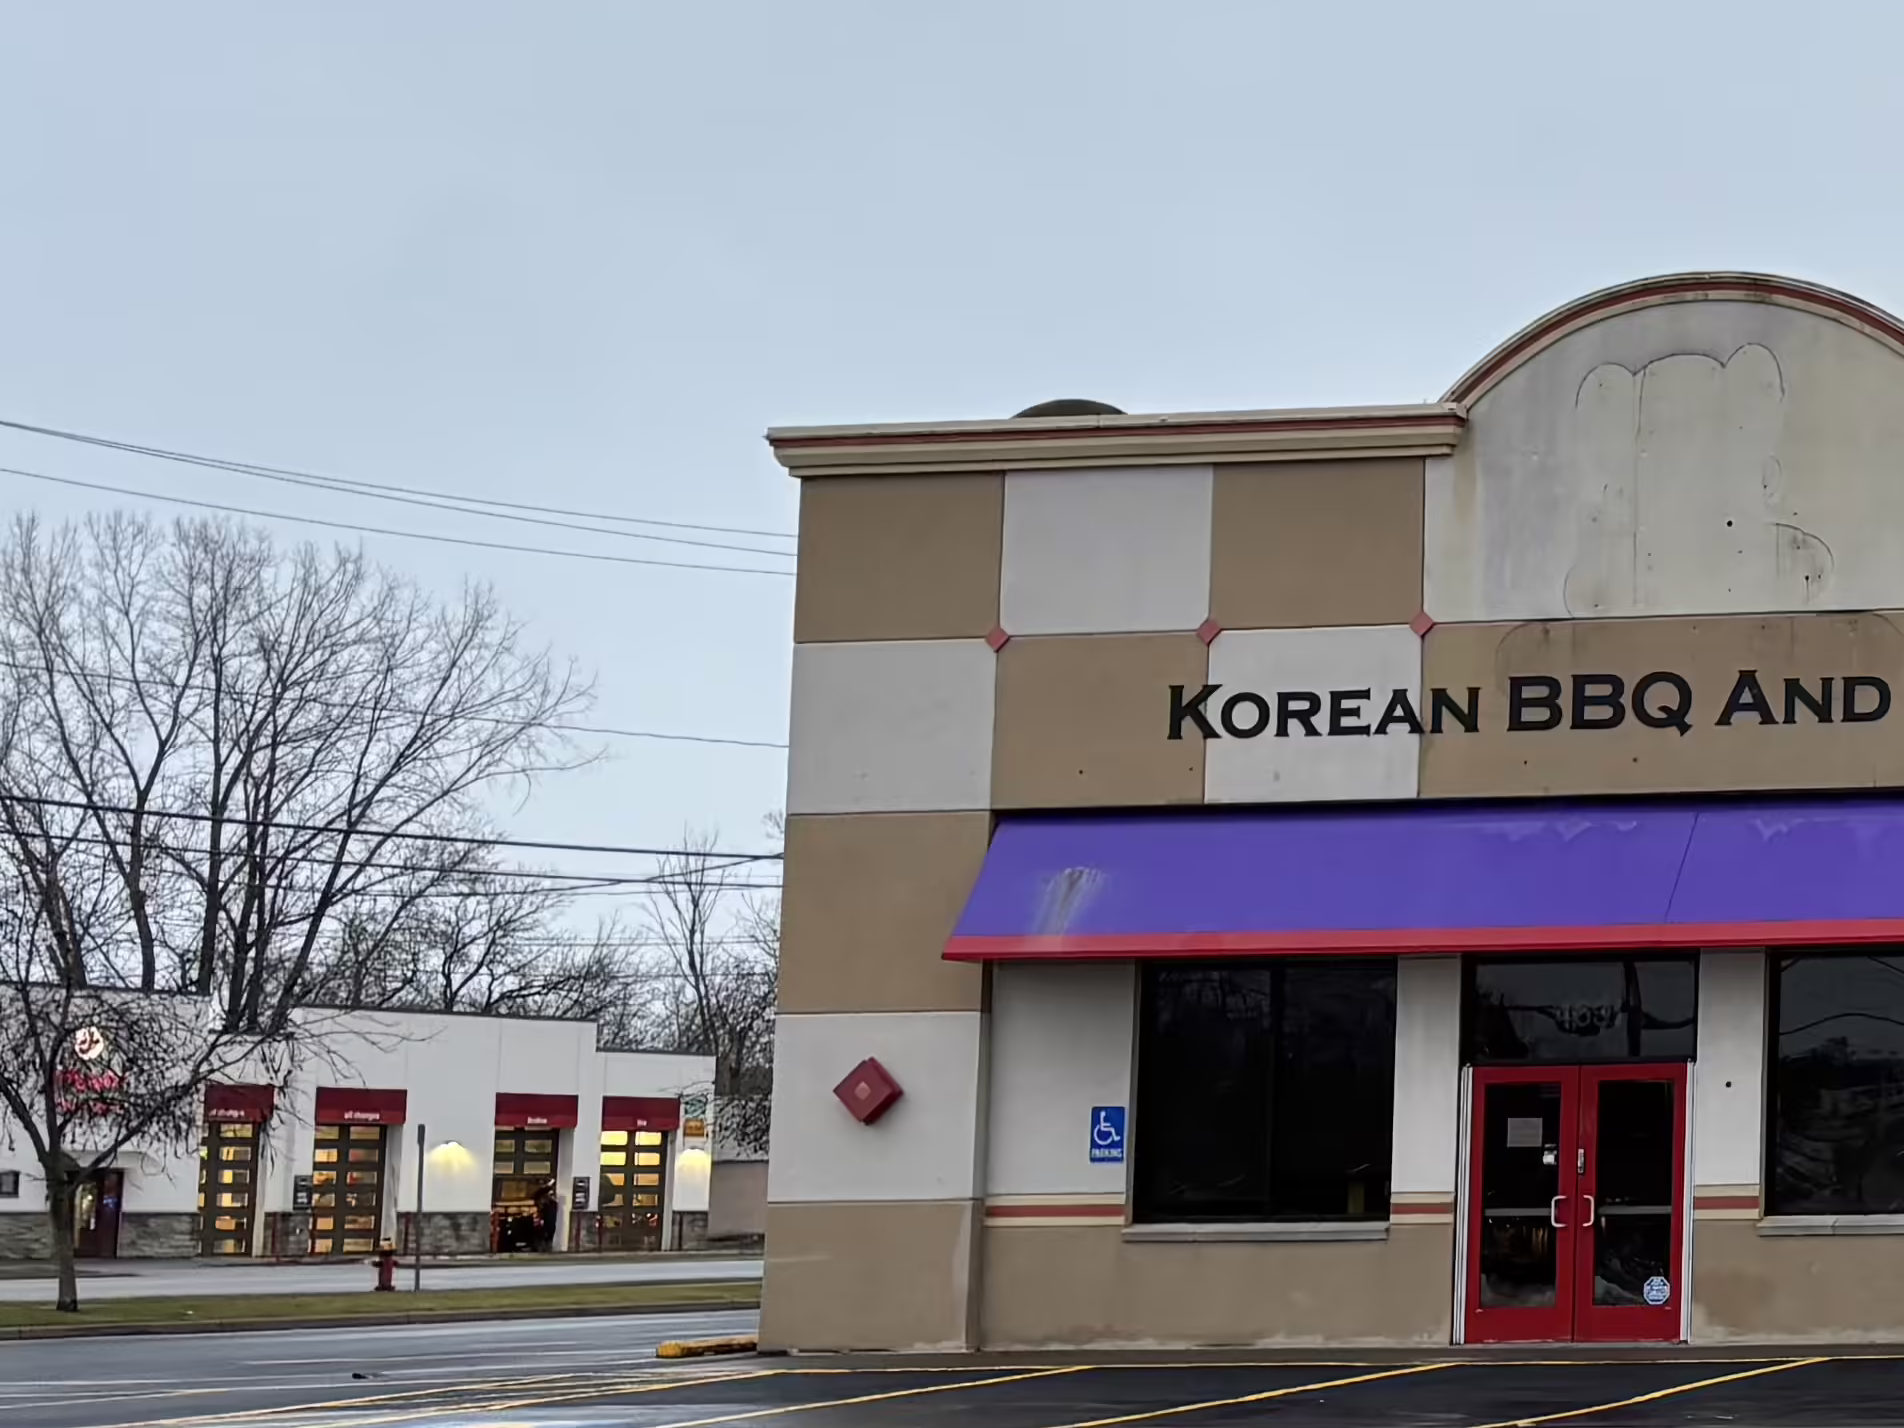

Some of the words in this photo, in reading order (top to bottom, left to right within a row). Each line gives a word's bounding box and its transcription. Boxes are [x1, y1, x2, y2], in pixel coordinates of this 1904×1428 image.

[1166, 683, 1482, 742] KOREAN
[1506, 670, 1694, 738] BBQ
[1713, 668, 1893, 727] AND
